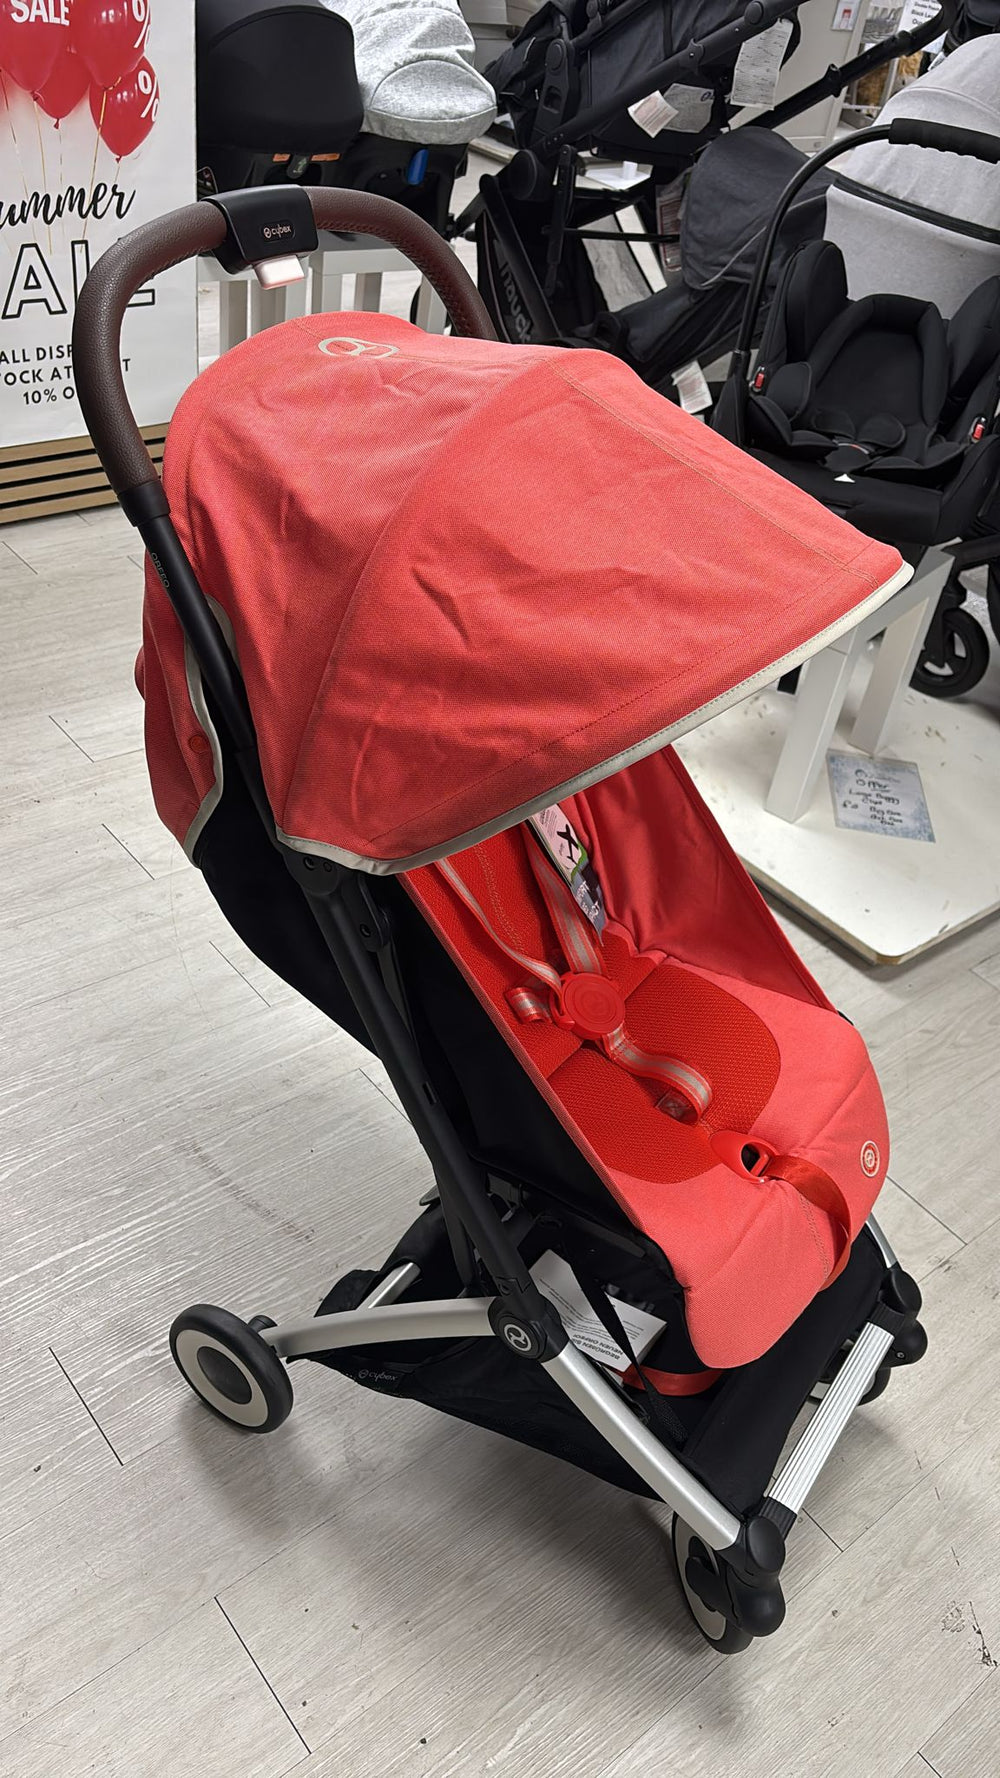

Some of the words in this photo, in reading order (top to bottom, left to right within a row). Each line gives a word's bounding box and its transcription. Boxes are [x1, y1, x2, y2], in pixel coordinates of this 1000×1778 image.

[10, 0, 70, 26] SALE
[0, 183, 136, 229] ummer
[271, 224, 292, 238] cybex
[0, 348, 30, 364] ALL
[0, 368, 43, 386] OCK
[23, 388, 57, 405] 10%
[369, 1371, 398, 1382] cybex
